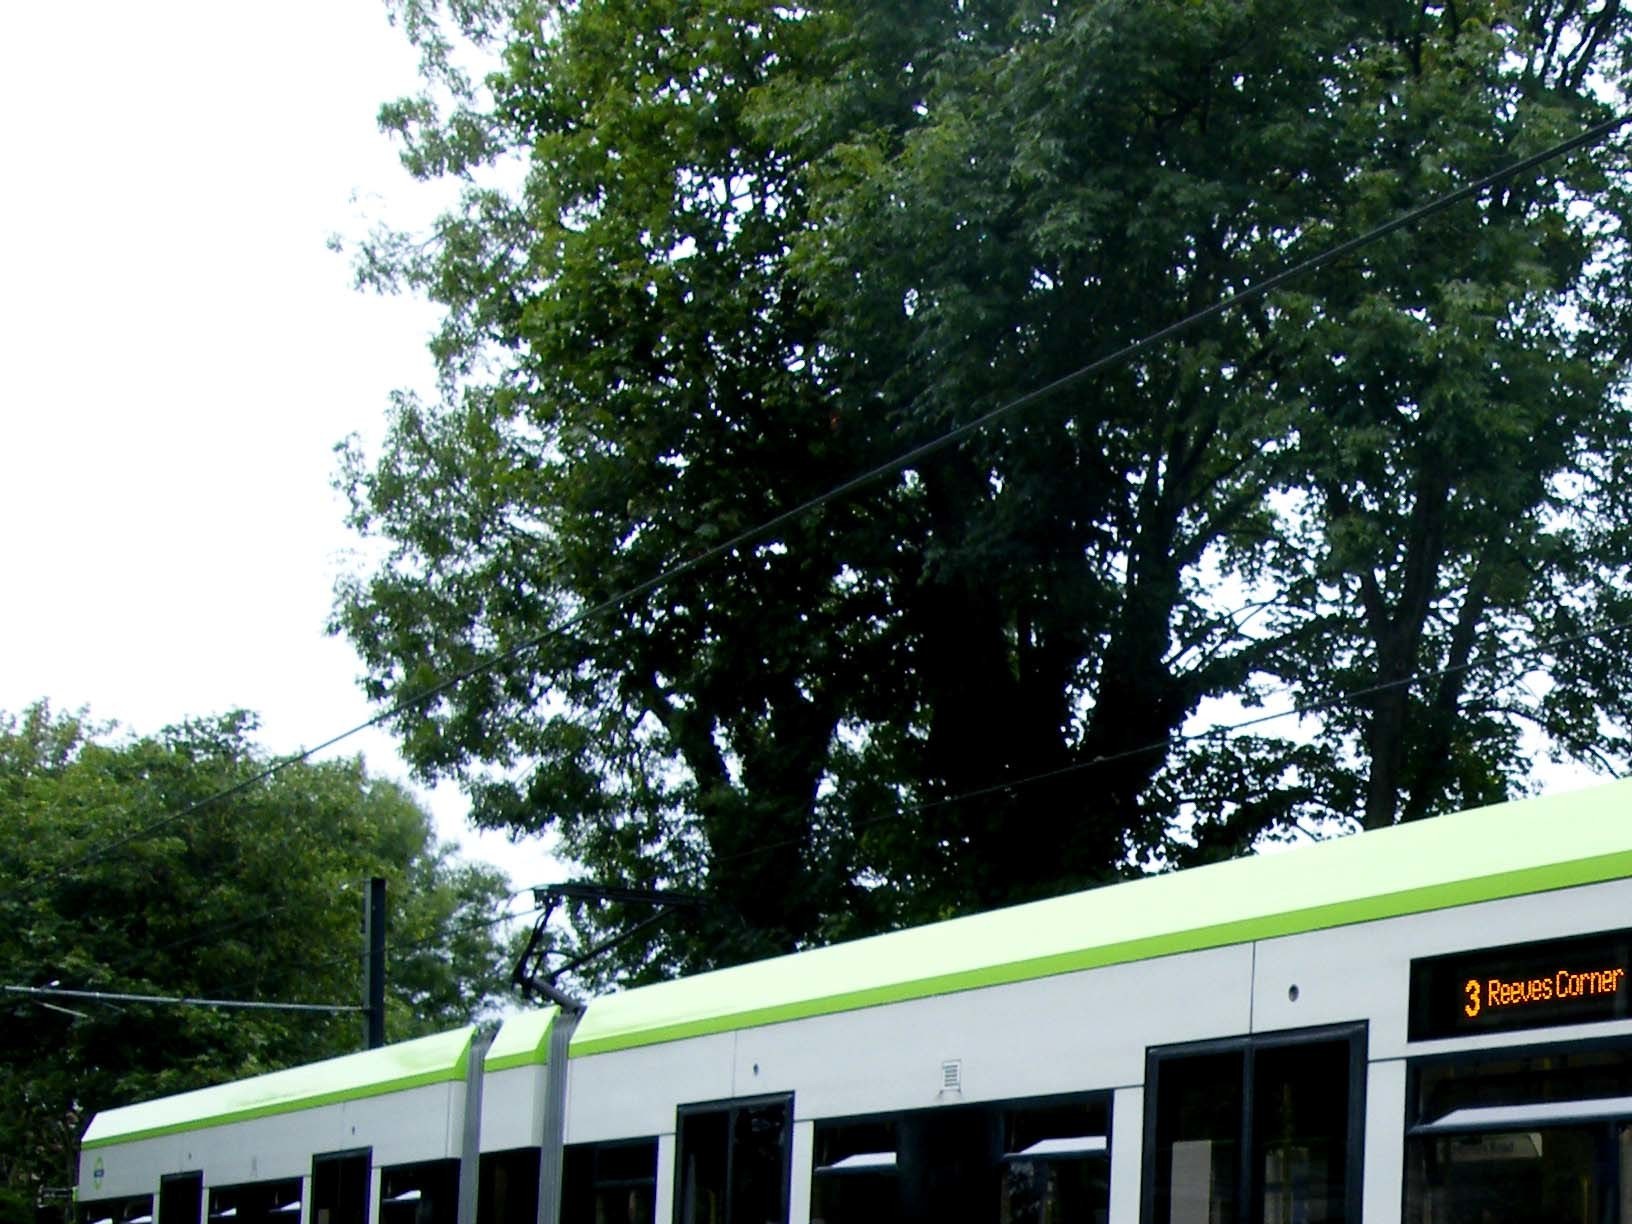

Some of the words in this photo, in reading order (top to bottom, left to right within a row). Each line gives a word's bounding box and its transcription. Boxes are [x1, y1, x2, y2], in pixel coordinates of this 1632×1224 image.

[1465, 979, 1481, 1017] 3
[1488, 979, 1553, 1007] Reeves
[1556, 968, 1625, 998] Corner
